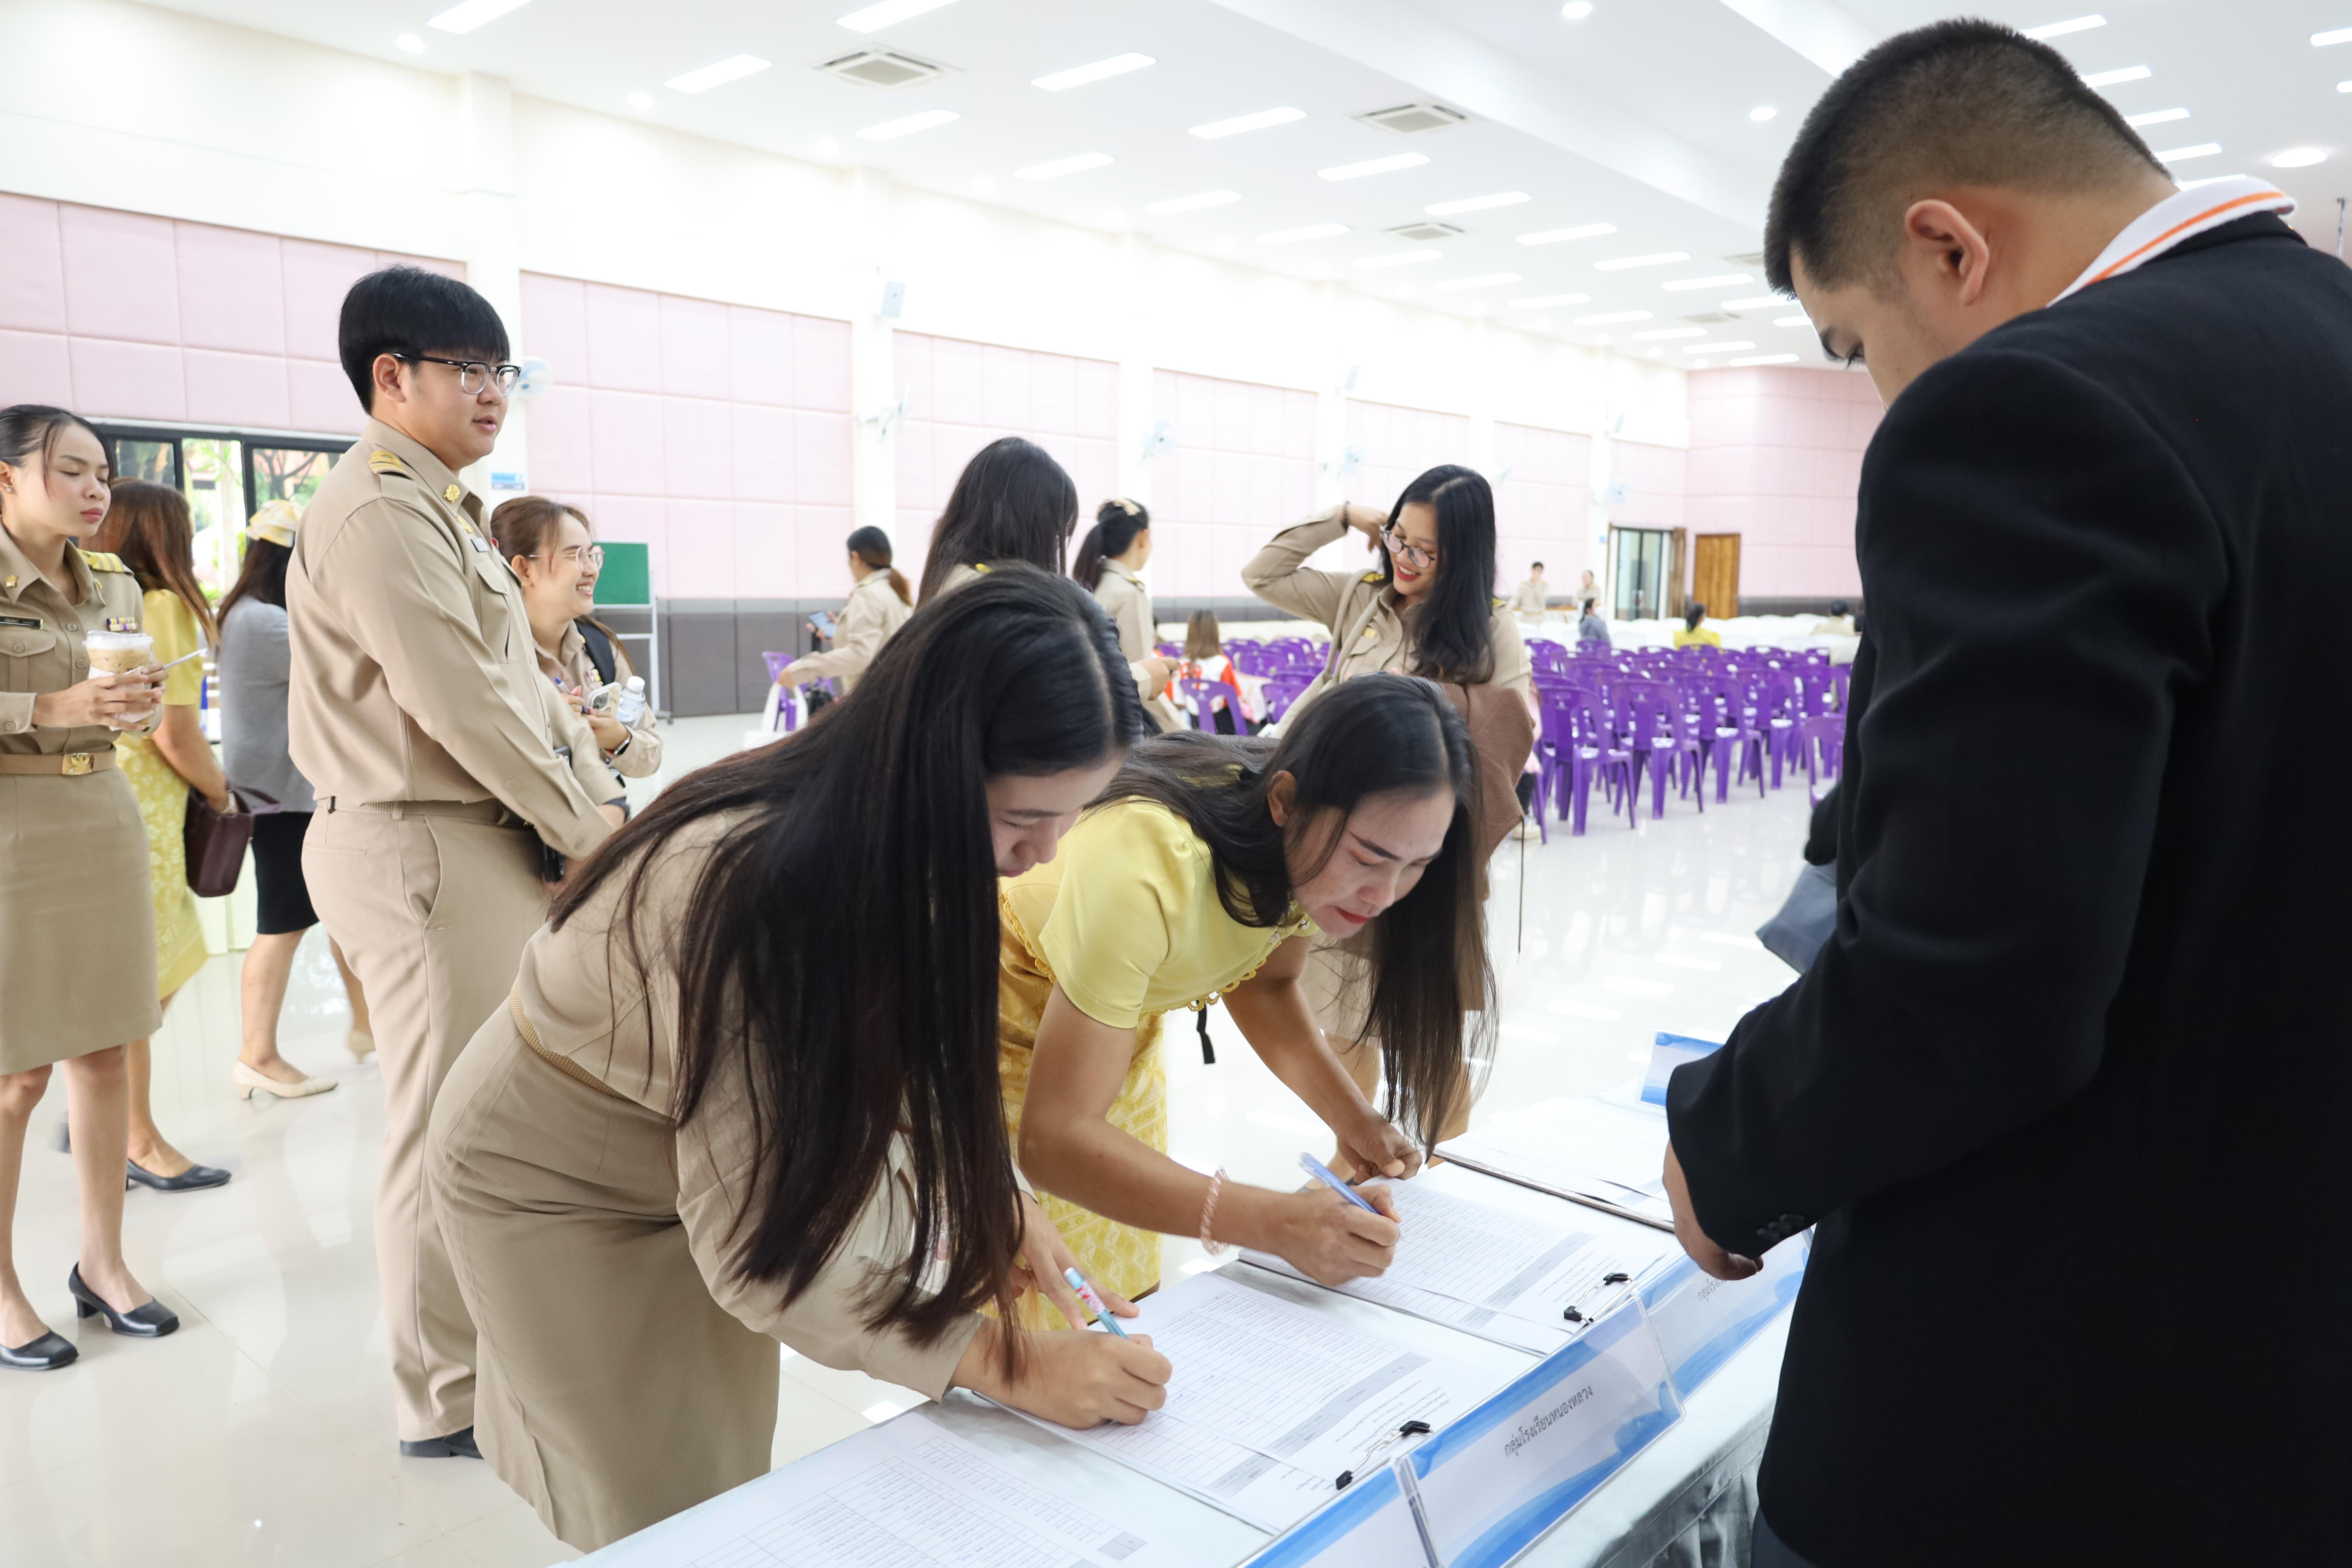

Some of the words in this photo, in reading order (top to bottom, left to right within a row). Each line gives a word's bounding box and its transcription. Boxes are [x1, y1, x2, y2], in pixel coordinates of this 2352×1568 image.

[1504, 1385, 1593, 1457] กลุ่มโรงเรียนหนองหลวง
